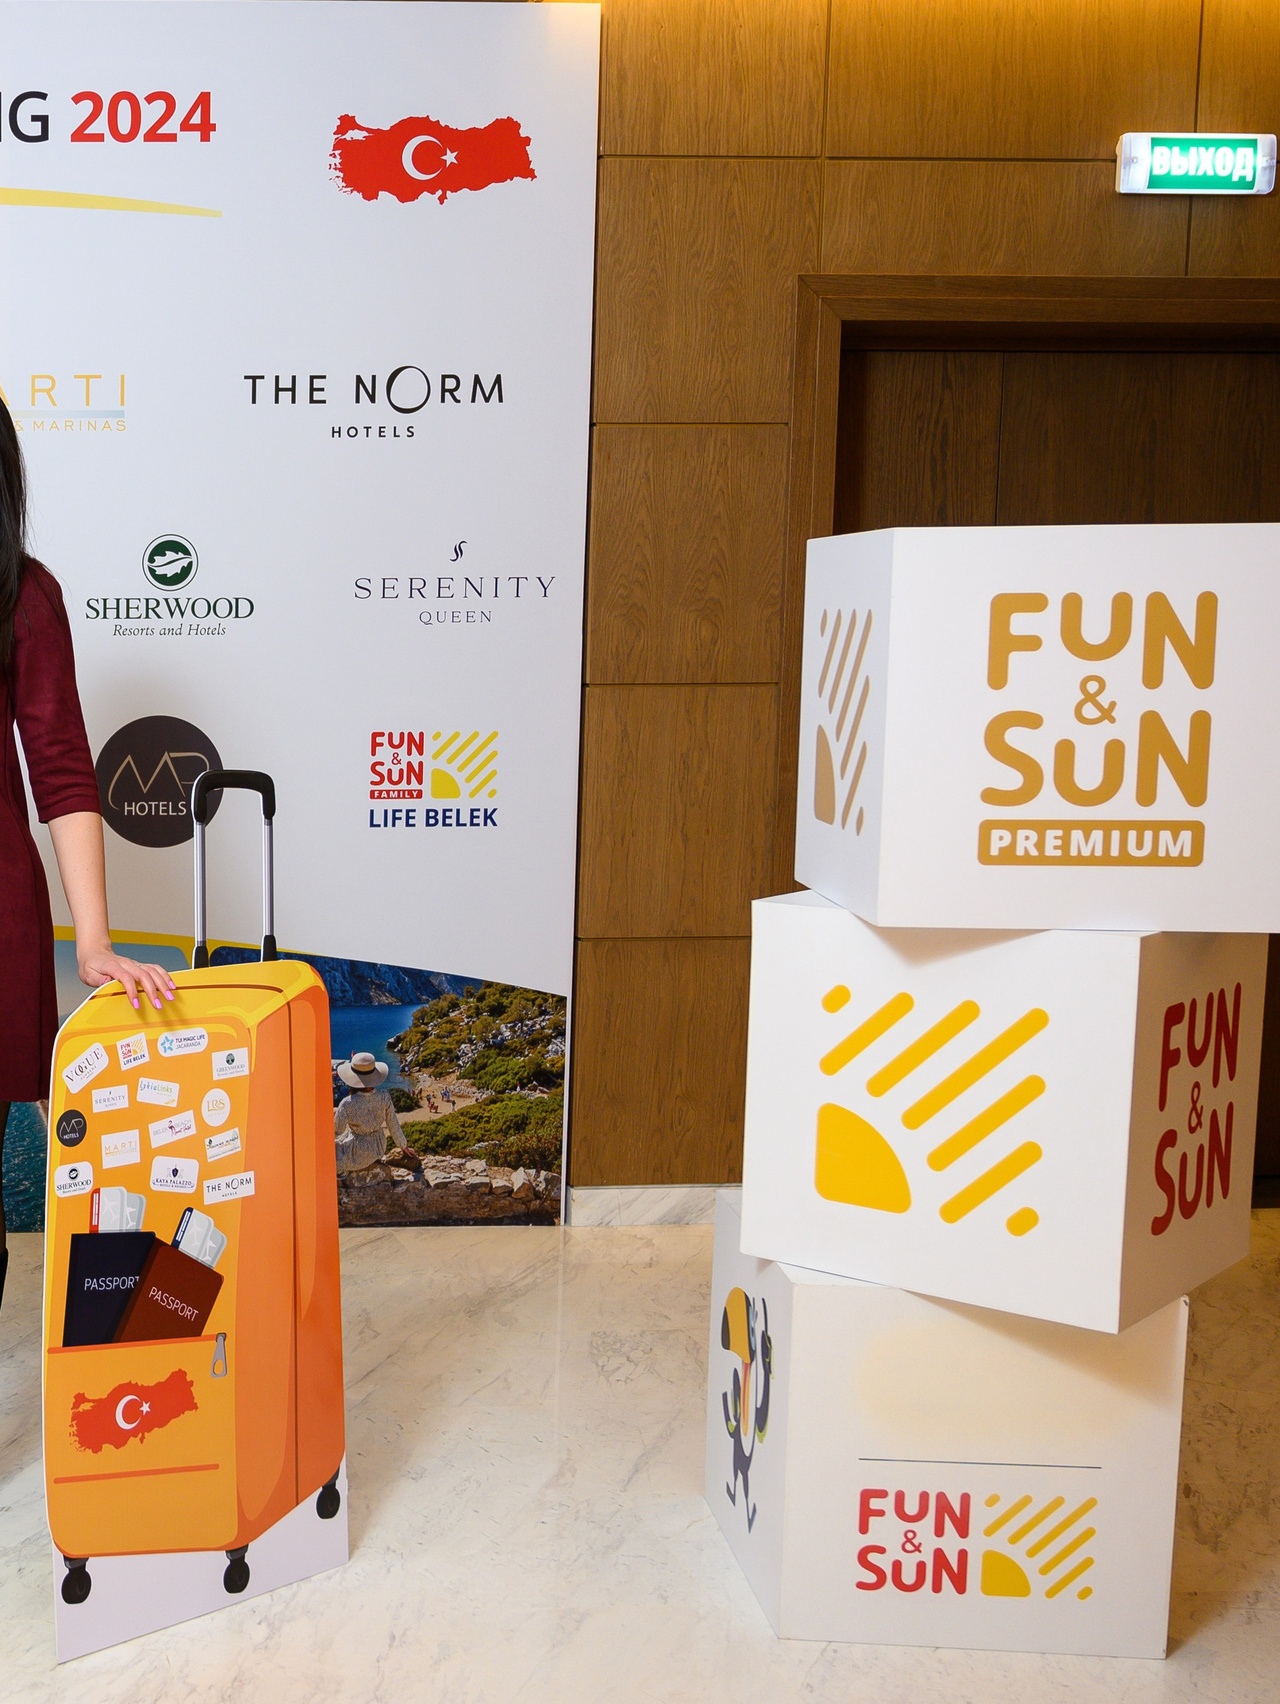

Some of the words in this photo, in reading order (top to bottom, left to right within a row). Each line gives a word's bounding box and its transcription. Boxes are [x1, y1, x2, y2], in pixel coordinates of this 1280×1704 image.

[70, 90, 217, 143] 2024
[1152, 146, 1254, 182] ВЫХОД
[244, 374, 328, 405] THE
[355, 365, 505, 414] NORM
[33, 420, 127, 432] MARINAS
[331, 425, 416, 439] HOTELS
[354, 576, 557, 600] SERENITY
[85, 597, 255, 620] SHERWOOD
[419, 610, 493, 626] QUEEN
[112, 623, 155, 637] Resorts
[159, 623, 183, 637] and
[187, 623, 227, 637] Hotels
[987, 591, 1219, 690] FUN
[1074, 674, 1117, 725] &
[370, 731, 424, 757] FUN
[391, 752, 402, 766] &
[980, 710, 1212, 808] SUN
[370, 761, 424, 787] SUN
[374, 789, 420, 799] FAMILY
[124, 801, 187, 816] HOTELS
[369, 809, 417, 828] LIFE
[425, 807, 498, 828] BELEK
[990, 828, 1192, 858] PREMIUM
[1158, 982, 1242, 1113] FUN
[65, 1047, 103, 1082] VOGUE
[95, 1095, 126, 1104] SERENITY
[1188, 1081, 1204, 1134] &
[63, 1132, 80, 1140] HOTELS
[104, 1141, 137, 1152] MARTI
[1151, 1101, 1235, 1236] SUN
[56, 1179, 91, 1191] SHERWOOD
[206, 1183, 222, 1193] THE
[225, 1177, 252, 1190] NORM
[148, 1286, 199, 1322] PASSPORT
[858, 1488, 971, 1539] FUN
[901, 1530, 923, 1554] &
[855, 1545, 969, 1595] SUN
